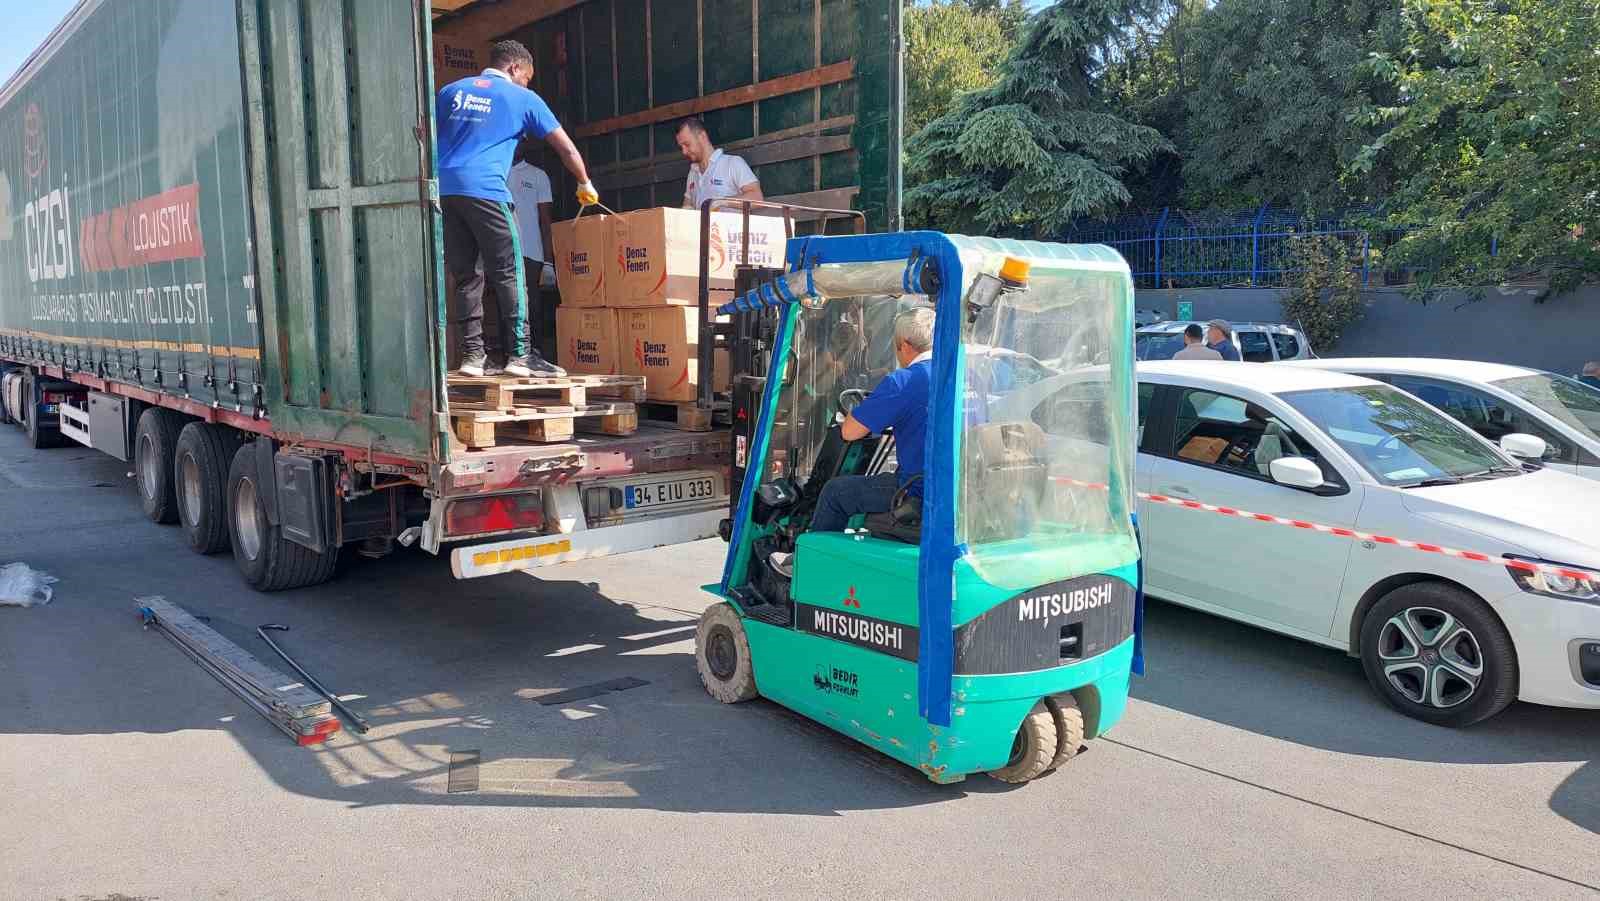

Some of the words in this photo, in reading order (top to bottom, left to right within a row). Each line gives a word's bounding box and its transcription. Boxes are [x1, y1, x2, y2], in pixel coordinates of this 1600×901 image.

[634, 487, 651, 504] 34
[658, 482, 682, 501] EIU
[689, 479, 712, 498] 333
[1018, 582, 1113, 622] MITSUBISHI
[814, 609, 902, 650] MITSUBISHI
